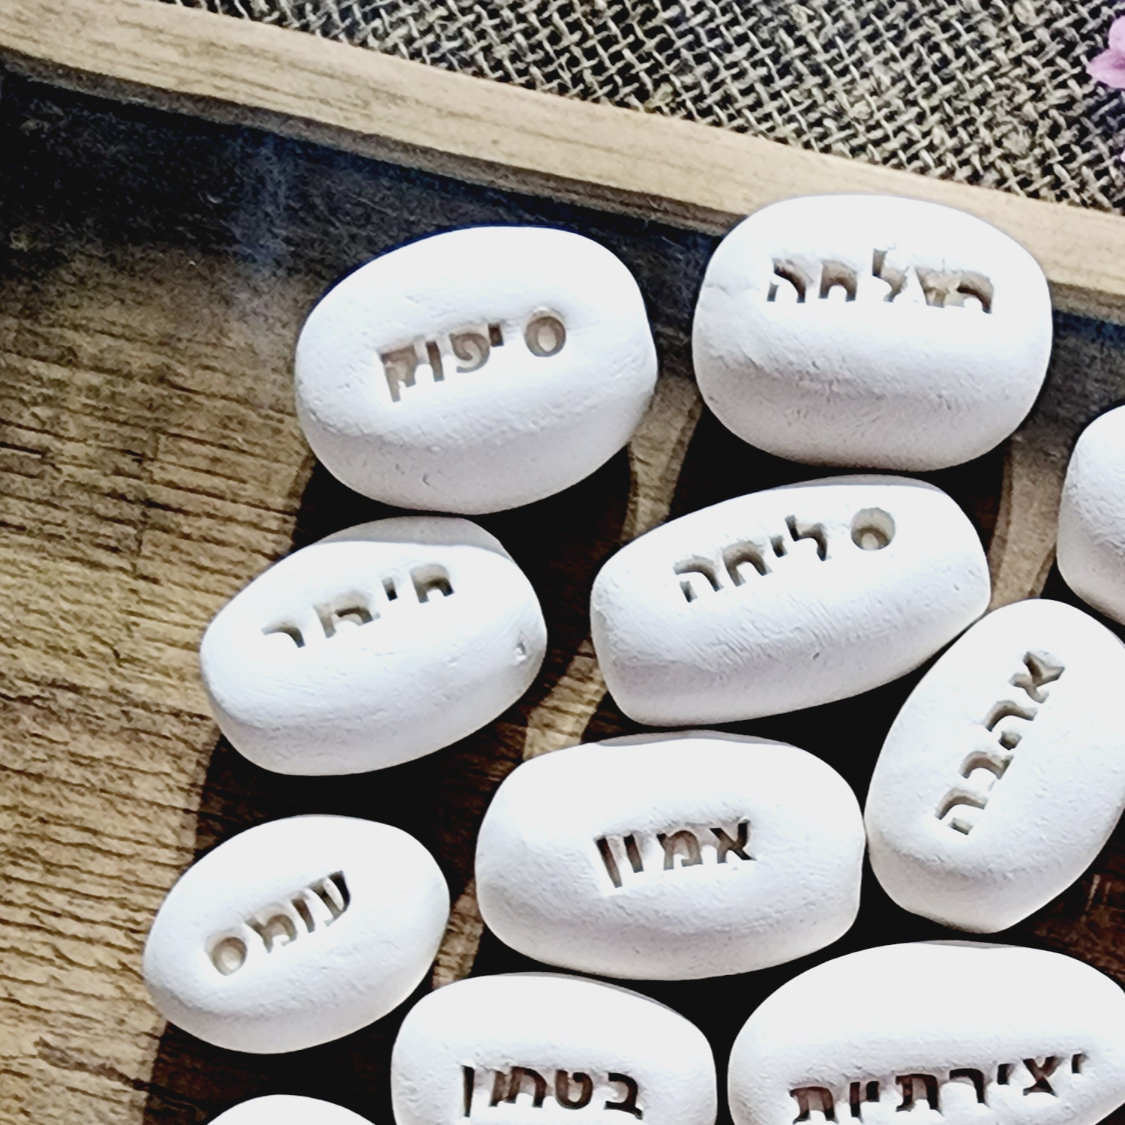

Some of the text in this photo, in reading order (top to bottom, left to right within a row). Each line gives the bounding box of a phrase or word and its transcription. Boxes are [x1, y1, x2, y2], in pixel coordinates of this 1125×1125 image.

[766, 248, 994, 315] הצלחה
[376, 307, 567, 403] סיפוק
[673, 506, 896, 604] סליחה
[934, 651, 1066, 836] אהבה
[593, 815, 758, 889] אמון
[209, 870, 352, 976] עומס
[460, 1062, 647, 1121] בטחון
